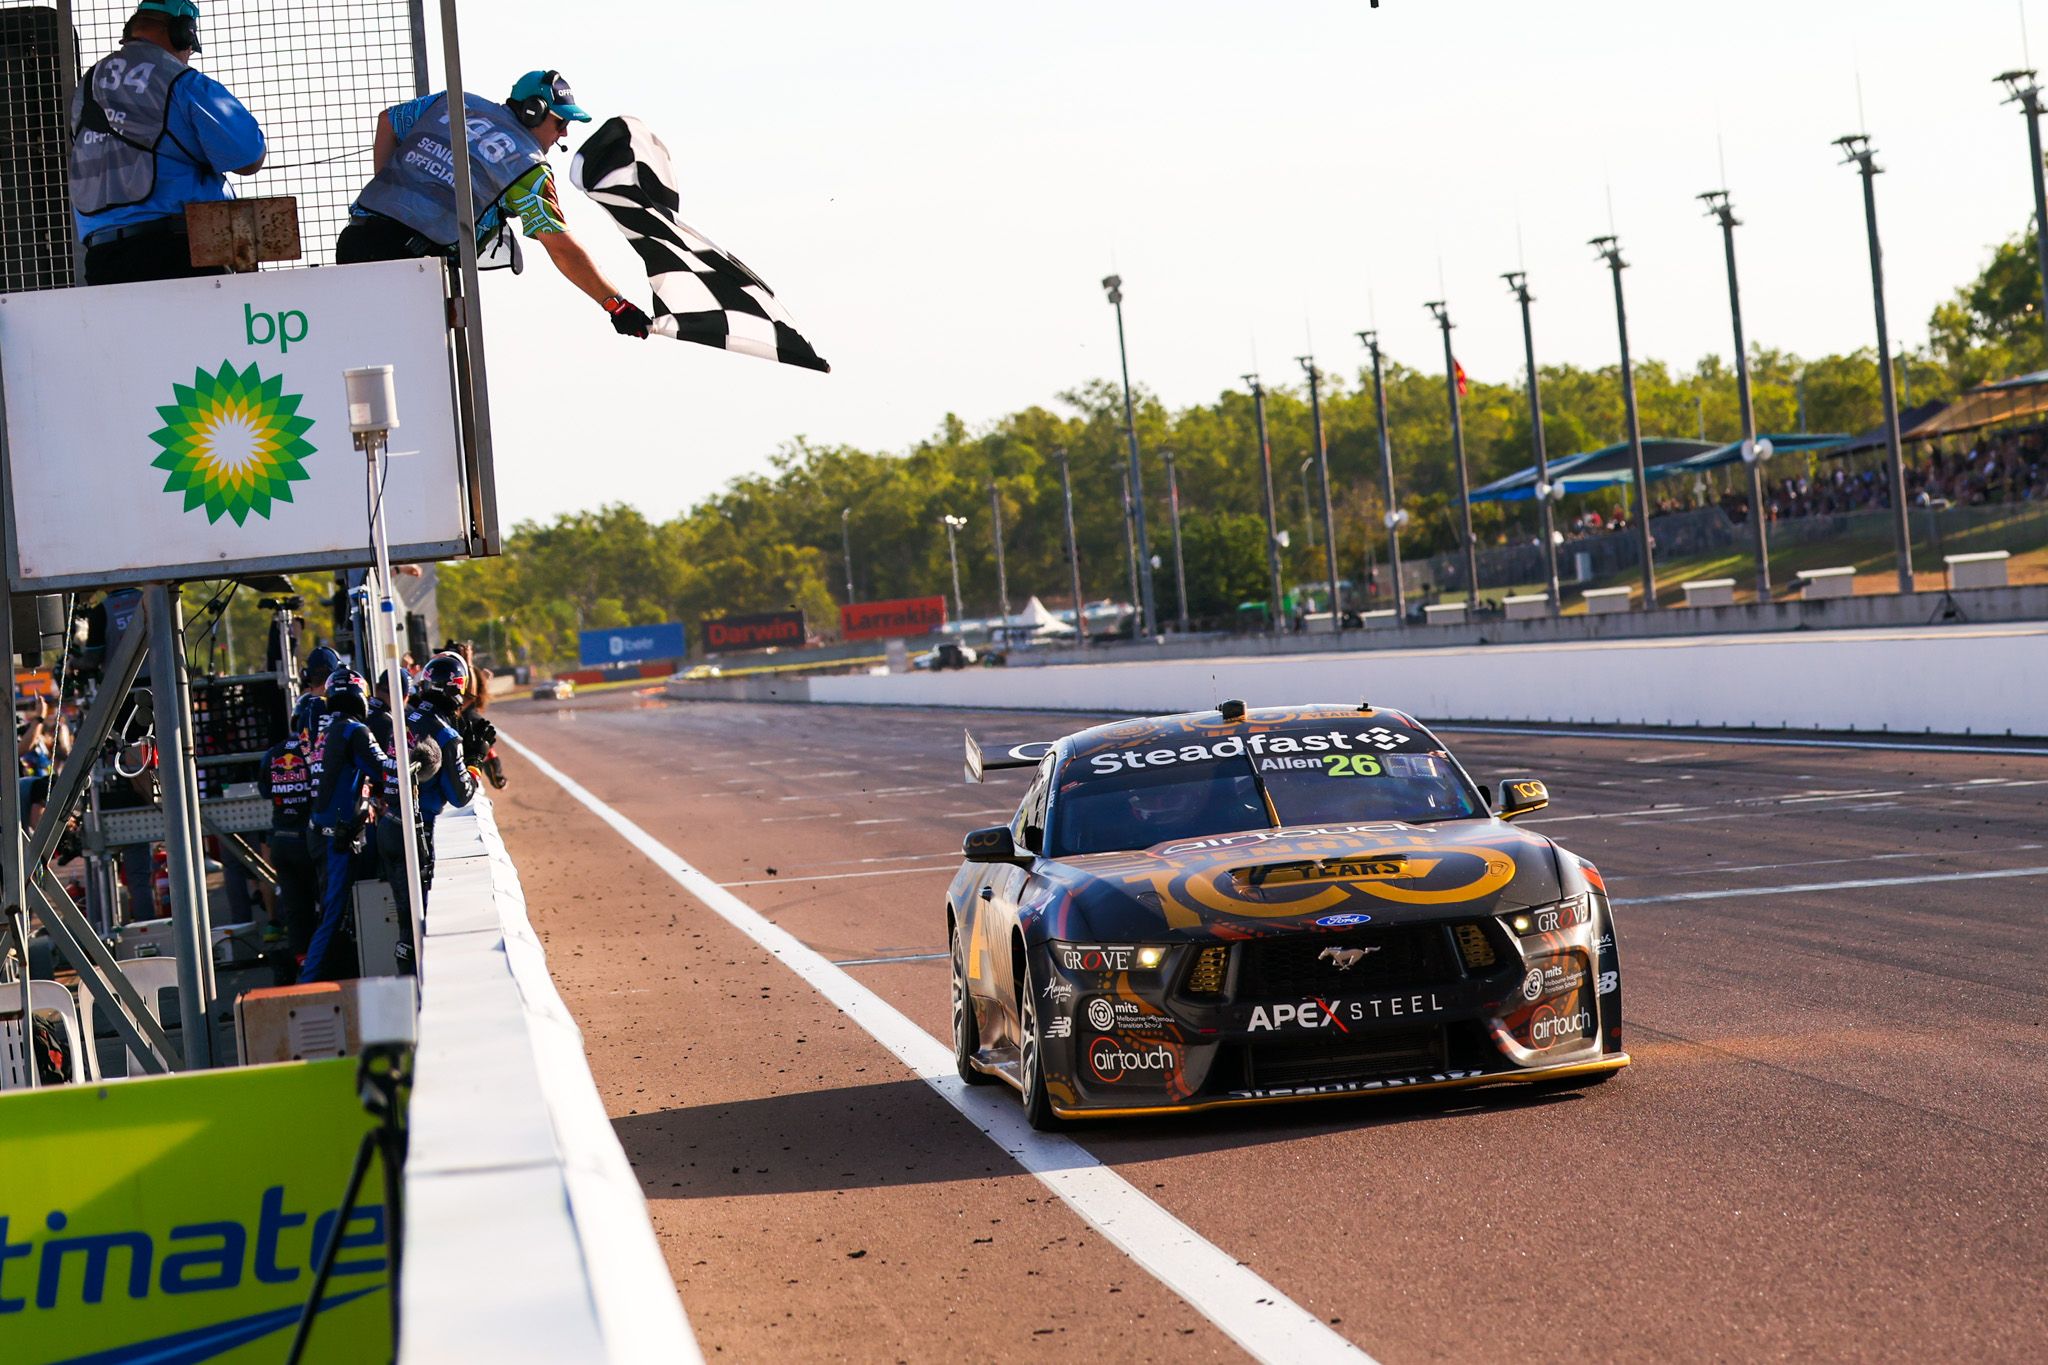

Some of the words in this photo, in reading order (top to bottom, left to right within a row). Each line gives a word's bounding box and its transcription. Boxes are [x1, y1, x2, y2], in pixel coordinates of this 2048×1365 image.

[99, 58, 156, 94] 34
[405, 150, 456, 188] OFFICIA
[244, 303, 308, 353] bp
[709, 618, 799, 647] Darwin
[845, 605, 943, 633] Larrakia
[1090, 731, 1353, 775] Steadfast
[1260, 755, 1323, 772] Allen
[1322, 754, 1382, 777] 26
[271, 782, 312, 794] AMPOL
[1163, 822, 1438, 856] airtouch
[1326, 915, 1360, 926] Ford
[1538, 903, 1588, 932] GROVE
[1545, 965, 1563, 979] mits
[1114, 1001, 1139, 1014] mits
[1116, 1015, 1146, 1023] Melbourne
[1247, 995, 1349, 1033] APEX
[1350, 994, 1444, 1021] STEEL
[1117, 1021, 1144, 1029] Transition
[1533, 1006, 1591, 1041] airtouch
[1094, 1045, 1174, 1071] airtouch
